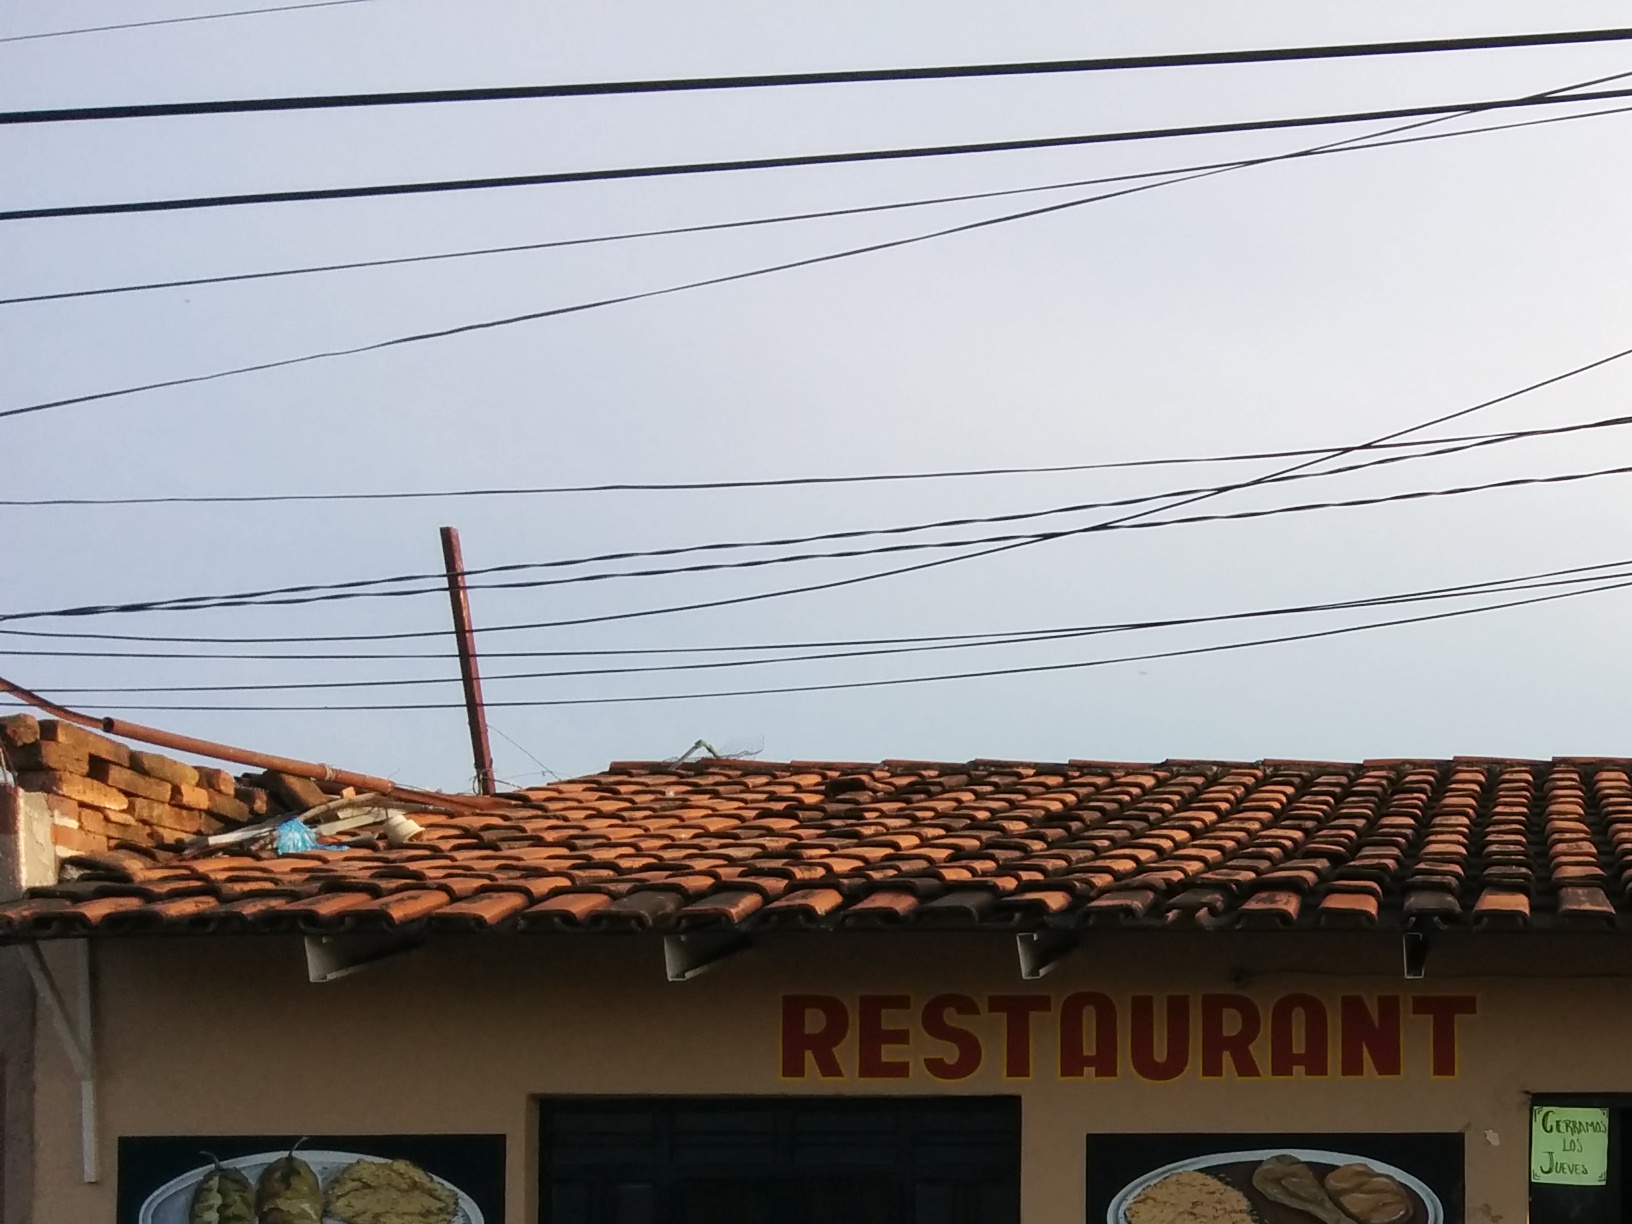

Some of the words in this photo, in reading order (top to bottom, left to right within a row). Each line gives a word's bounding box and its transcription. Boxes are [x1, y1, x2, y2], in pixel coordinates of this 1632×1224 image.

[780, 990, 1478, 1082] RESTAURANT
[1541, 1110, 1607, 1136] CERRAMOS
[1562, 1138, 1583, 1153] LOS
[1540, 1151, 1589, 1175] JUEVES
